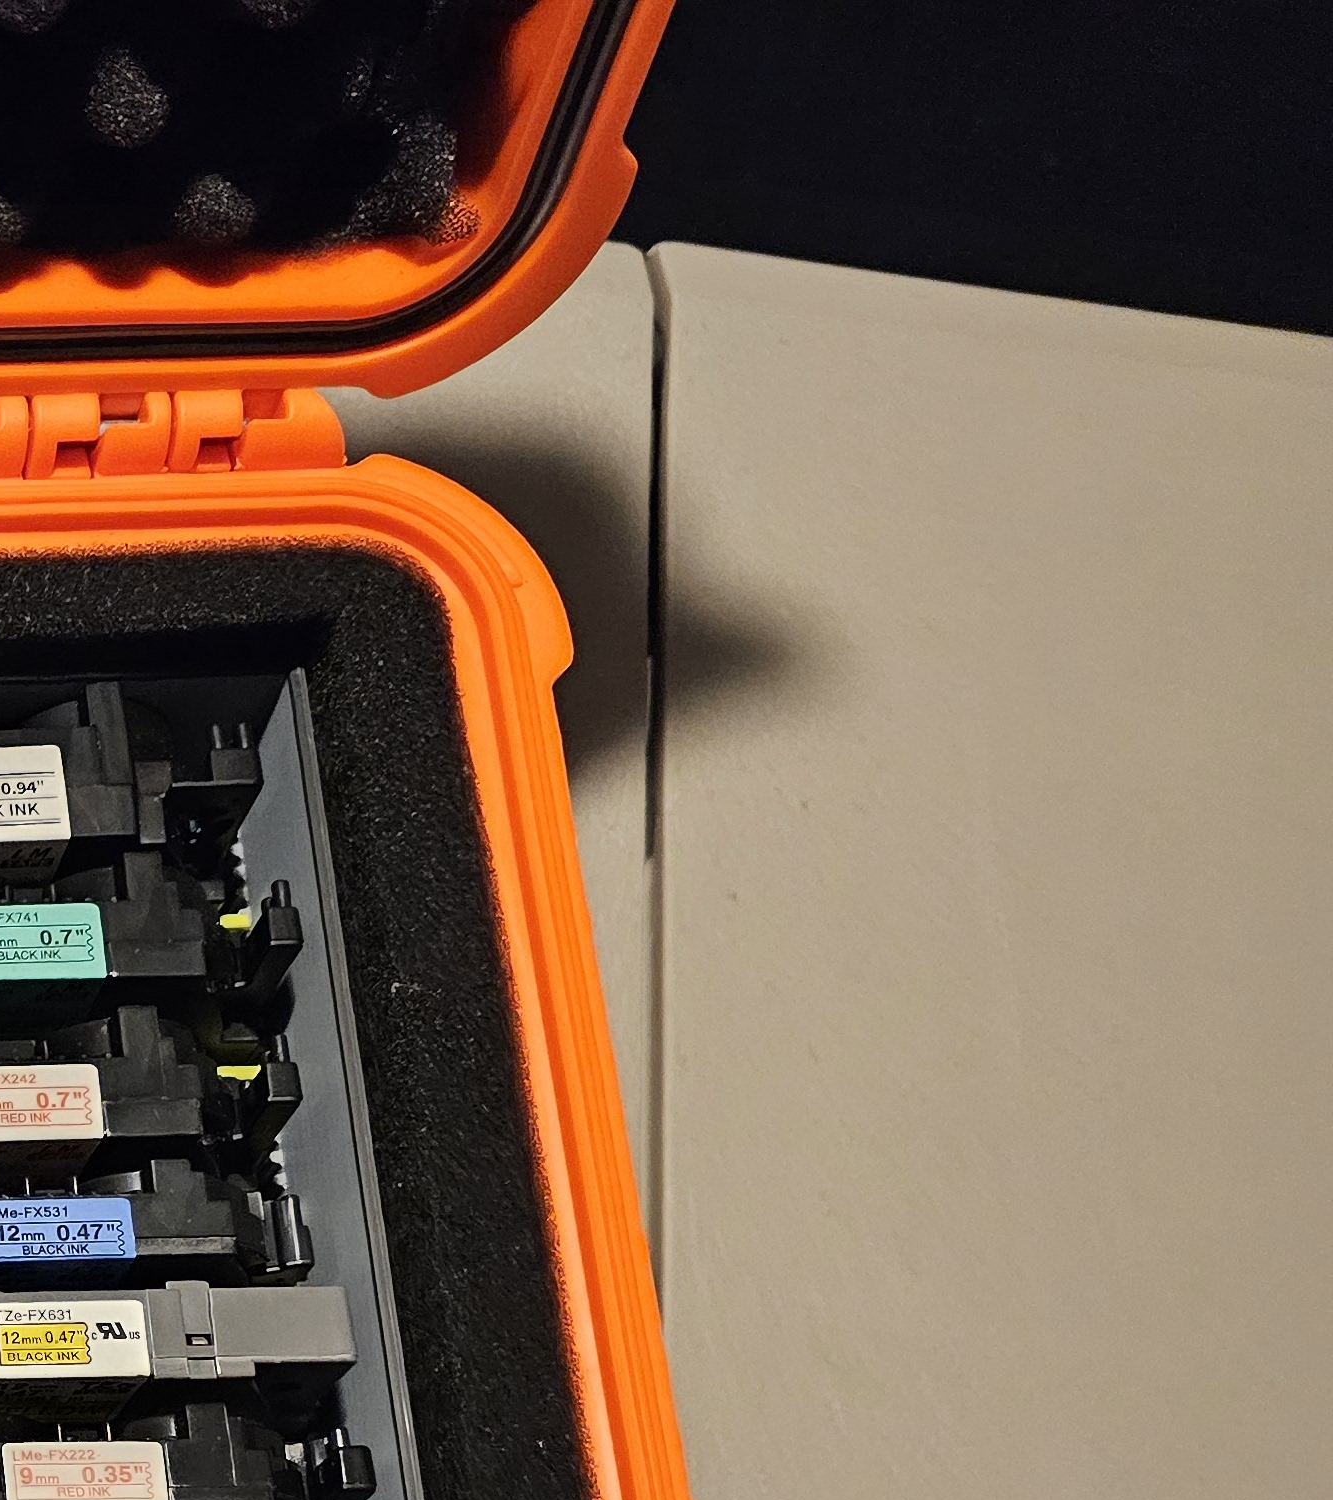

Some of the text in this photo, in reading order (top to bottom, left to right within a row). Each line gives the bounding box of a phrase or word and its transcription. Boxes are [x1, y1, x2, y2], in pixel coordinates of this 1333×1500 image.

[10, 803, 39, 816] INK
[40, 950, 61, 959] INK
[0, 1113, 51, 1123] RED INK
[22, 1244, 89, 1255] BLACK INK
[8, 1352, 79, 1361] BLACK INK
[13, 1450, 95, 1461] LMe-FX222
[57, 1486, 111, 1497] RED INK
